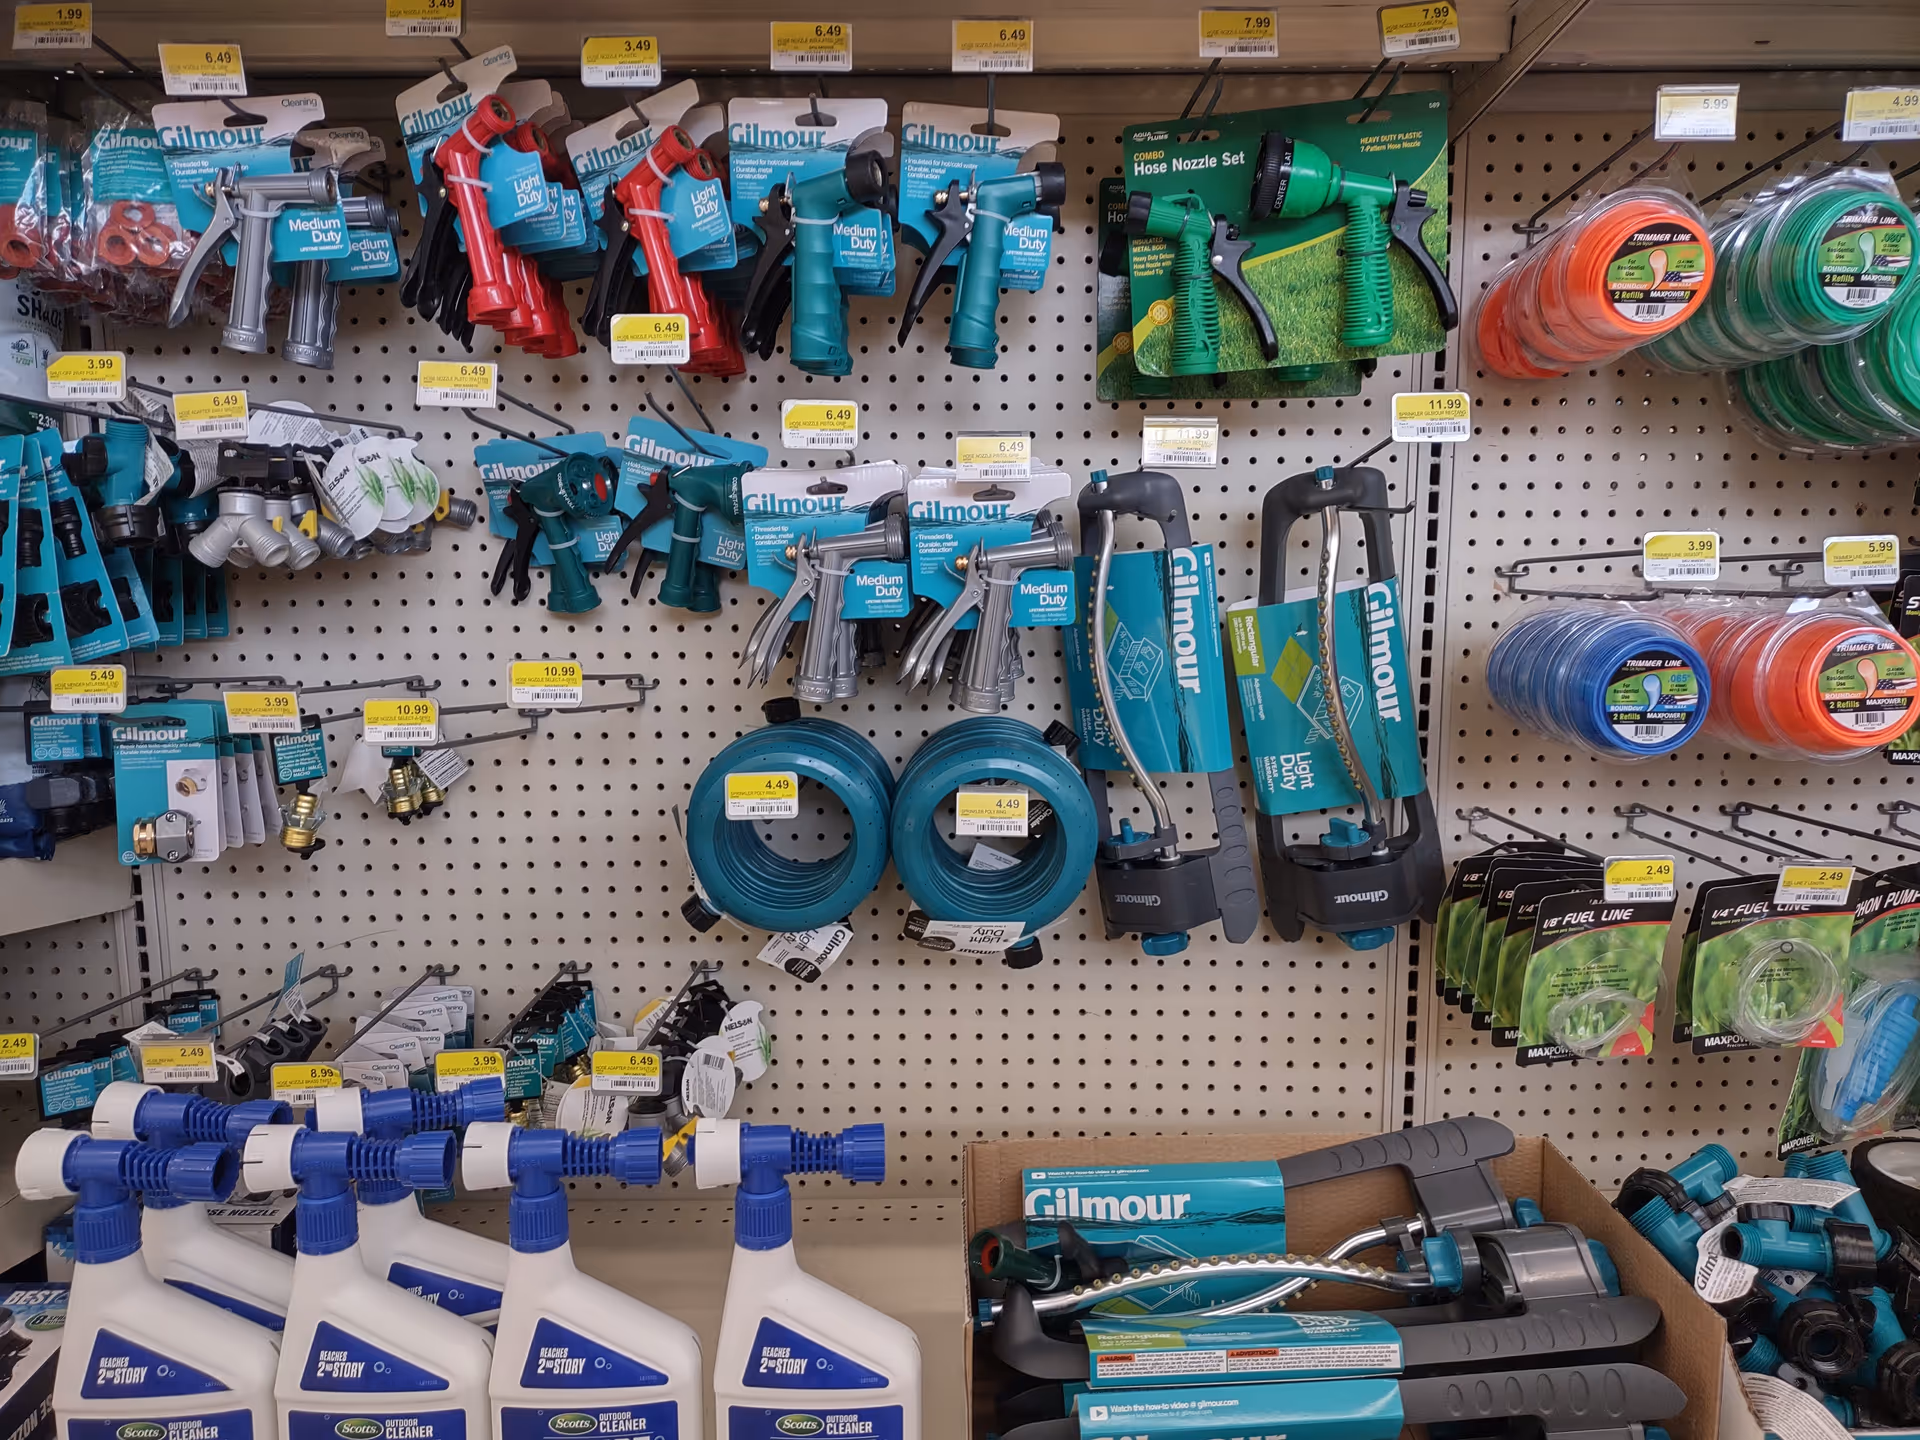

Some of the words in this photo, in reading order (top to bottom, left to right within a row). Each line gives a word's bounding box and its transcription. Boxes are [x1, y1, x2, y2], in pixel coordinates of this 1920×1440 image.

[56, 9, 83, 20] 1.99
[1422, 6, 1450, 20] 7.99
[1244, 17, 1271, 29] 7.99
[815, 25, 841, 37] 6.49
[999, 29, 1026, 41] 6.49
[624, 40, 651, 53] 3.49
[205, 51, 232, 65] 6.49
[483, 51, 511, 68] Cleaning
[281, 97, 318, 108] Cleaning
[1702, 98, 1729, 110] 5.99
[1892, 95, 1919, 107] 4.99
[401, 93, 473, 135] Gilmour
[158, 125, 264, 149] Gilmour
[729, 122, 826, 148] Gilmour
[902, 123, 1001, 154] Gilmour
[1360, 136, 1379, 144] HEAVY
[1380, 134, 1397, 143] DUTY
[1397, 131, 1422, 140] PLASTIC
[1401, 140, 1421, 149] Nozzle
[573, 128, 654, 175] Gilmour
[1133, 151, 1164, 162] COMBO
[1134, 162, 1167, 176] Hose
[1172, 154, 1217, 172] Nozzle
[1221, 151, 1245, 167] Set
[514, 175, 540, 195] Light
[517, 189, 542, 208] Duty
[690, 184, 717, 206] Light
[1274, 179, 1288, 210] CENTER
[694, 198, 720, 219] Duty
[289, 217, 341, 232] Medium
[1842, 215, 1877, 224] TRIMMER
[1879, 216, 1897, 225] LINE
[833, 223, 877, 237] Medium
[312, 230, 342, 245] Duty
[1632, 233, 1670, 242] TRIMMER
[1672, 233, 1691, 242] LINE
[851, 237, 877, 252] Duty
[1018, 238, 1047, 253] Duty
[361, 250, 390, 262] Duty
[1155, 268, 1163, 276] Tip
[1831, 274, 1855, 282] Refills
[1614, 291, 1620, 299] 2
[1621, 291, 1644, 299] Refills
[654, 321, 680, 334] 6.49
[87, 358, 114, 370] 3.99
[460, 365, 487, 377] 6.49
[213, 395, 238, 408] 6.49
[1428, 398, 1462, 411] 11.99
[826, 409, 852, 421] 6.49
[624, 434, 715, 468] Gilmour
[998, 441, 1025, 453] 6.49
[743, 493, 846, 514] Gilmour
[908, 500, 1010, 522] Gilmour
[595, 531, 620, 546] Light
[718, 536, 746, 552] Light
[1687, 540, 1713, 551] 3.99
[1868, 541, 1894, 553] 5.99
[716, 546, 743, 562] Duty
[856, 574, 903, 587] Medium
[875, 586, 903, 599] Duty
[1020, 582, 1068, 596] Medium
[1039, 595, 1068, 608] Duty
[1172, 547, 1201, 694] Gilmour
[1244, 615, 1260, 668] Rectangular
[1836, 642, 1874, 652] TRIMMER
[1876, 642, 1895, 651] LINE
[1367, 581, 1402, 723] Gilmour
[90, 670, 115, 680] 5.49
[544, 665, 576, 678] 10.99
[264, 697, 290, 708] 3.99
[396, 703, 429, 715] 10.99
[1829, 701, 1835, 709] 2
[1836, 700, 1860, 709] Refills
[30, 716, 81, 727] Gilmour
[112, 727, 188, 742] Gilmour
[274, 732, 321, 747] Gilmour
[1268, 756, 1279, 778] 5-YEAR
[1279, 753, 1297, 791] Duty
[1296, 751, 1315, 790] Light
[1262, 755, 1275, 793] WARRANTY
[765, 779, 790, 790] 4.49
[995, 798, 1020, 810] 4.49
[1645, 863, 1670, 876] 2.49
[1818, 871, 1844, 882] 2.49
[1115, 893, 1161, 907] Gilmour
[1334, 889, 1389, 904] Gilmour
[1734, 902, 1771, 917] FUEL
[1563, 910, 1596, 926] FUEL
[1601, 907, 1635, 922] LINE
[973, 926, 1004, 937] Duty
[969, 934, 1002, 945] Light
[815, 929, 846, 965] Gilmour
[417, 1006, 443, 1017] Cleaning
[2, 1037, 28, 1049] 2.49
[389, 1041, 416, 1052] Cleaning
[179, 1046, 205, 1059] 2.49
[372, 1063, 400, 1071] Cleaning
[473, 1055, 497, 1067] 3.99
[630, 1056, 653, 1067] 6.49
[44, 1065, 93, 1082] Gilmour
[310, 1068, 335, 1079] 8.99
[1025, 1187, 1191, 1222] Gilmour
[228, 1209, 281, 1217] NOZZLE
[3, 1290, 64, 1306] BEST
[319, 1350, 348, 1362] REACHES
[540, 1347, 569, 1359] REACHES
[762, 1347, 790, 1359] REACHES
[1103, 1354, 1133, 1363] WARNING
[1235, 1349, 1277, 1357] ADVERTENCIA
[100, 1356, 130, 1368] REACHES
[553, 1357, 587, 1375] STORY
[775, 1358, 808, 1375] STORY
[114, 1366, 148, 1384] STORY
[332, 1361, 365, 1378] STORY
[1110, 1404, 1132, 1413] Watch
[1132, 1403, 1145, 1411] the
[1145, 1402, 1169, 1411] how-to
[1170, 1400, 1189, 1410] video
[1197, 1398, 1239, 1409] gilmour.com
[555, 1416, 591, 1429] Scotts
[599, 1411, 632, 1421] OUTDOOR
[826, 1414, 858, 1424] OUTDOOR
[168, 1420, 202, 1431] OUTDOOR
[341, 1423, 377, 1435] Scotts
[385, 1418, 418, 1428] OUTDOOR
[599, 1418, 647, 1433] CLEANER
[782, 1418, 818, 1431] Scotts
[826, 1421, 873, 1436] CLEANER
[123, 1427, 160, 1439] Scotts
[168, 1426, 219, 1440] CLEANER
[385, 1425, 434, 1440] CLEANER
